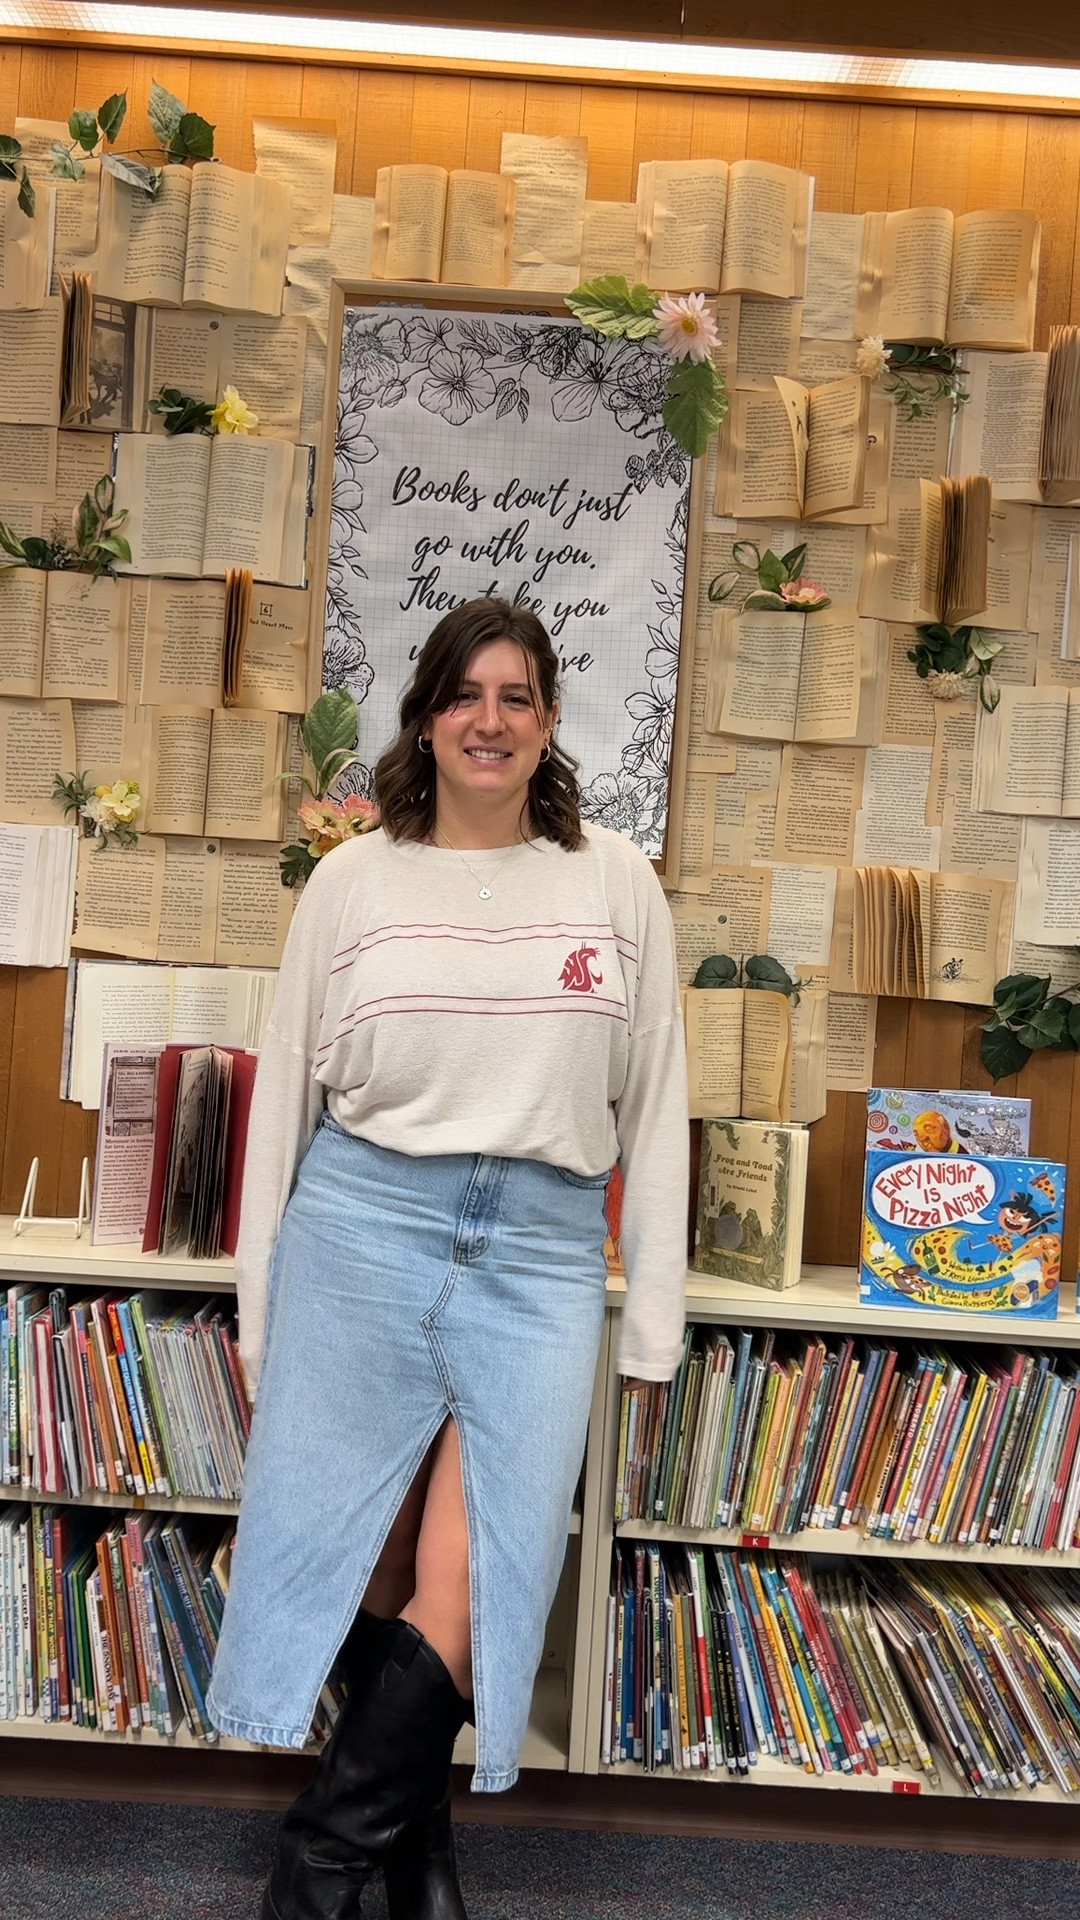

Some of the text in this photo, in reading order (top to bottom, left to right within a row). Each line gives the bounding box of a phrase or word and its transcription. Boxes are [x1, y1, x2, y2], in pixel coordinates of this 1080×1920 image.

[391, 465, 635, 530] Books don't just
[411, 519, 597, 582] go with you.
[551, 595, 611, 636] you
[714, 1154, 773, 1171] Frog and Toad
[718, 1167, 767, 1182] Are Friends
[876, 1162, 977, 1198] Every Night
[890, 1184, 989, 1227] Pizza Night
[908, 1402, 923, 1439] ROBERTO
[752, 1538, 758, 1546] K
[22, 1584, 27, 1592] MY
[902, 1782, 908, 1792] L
